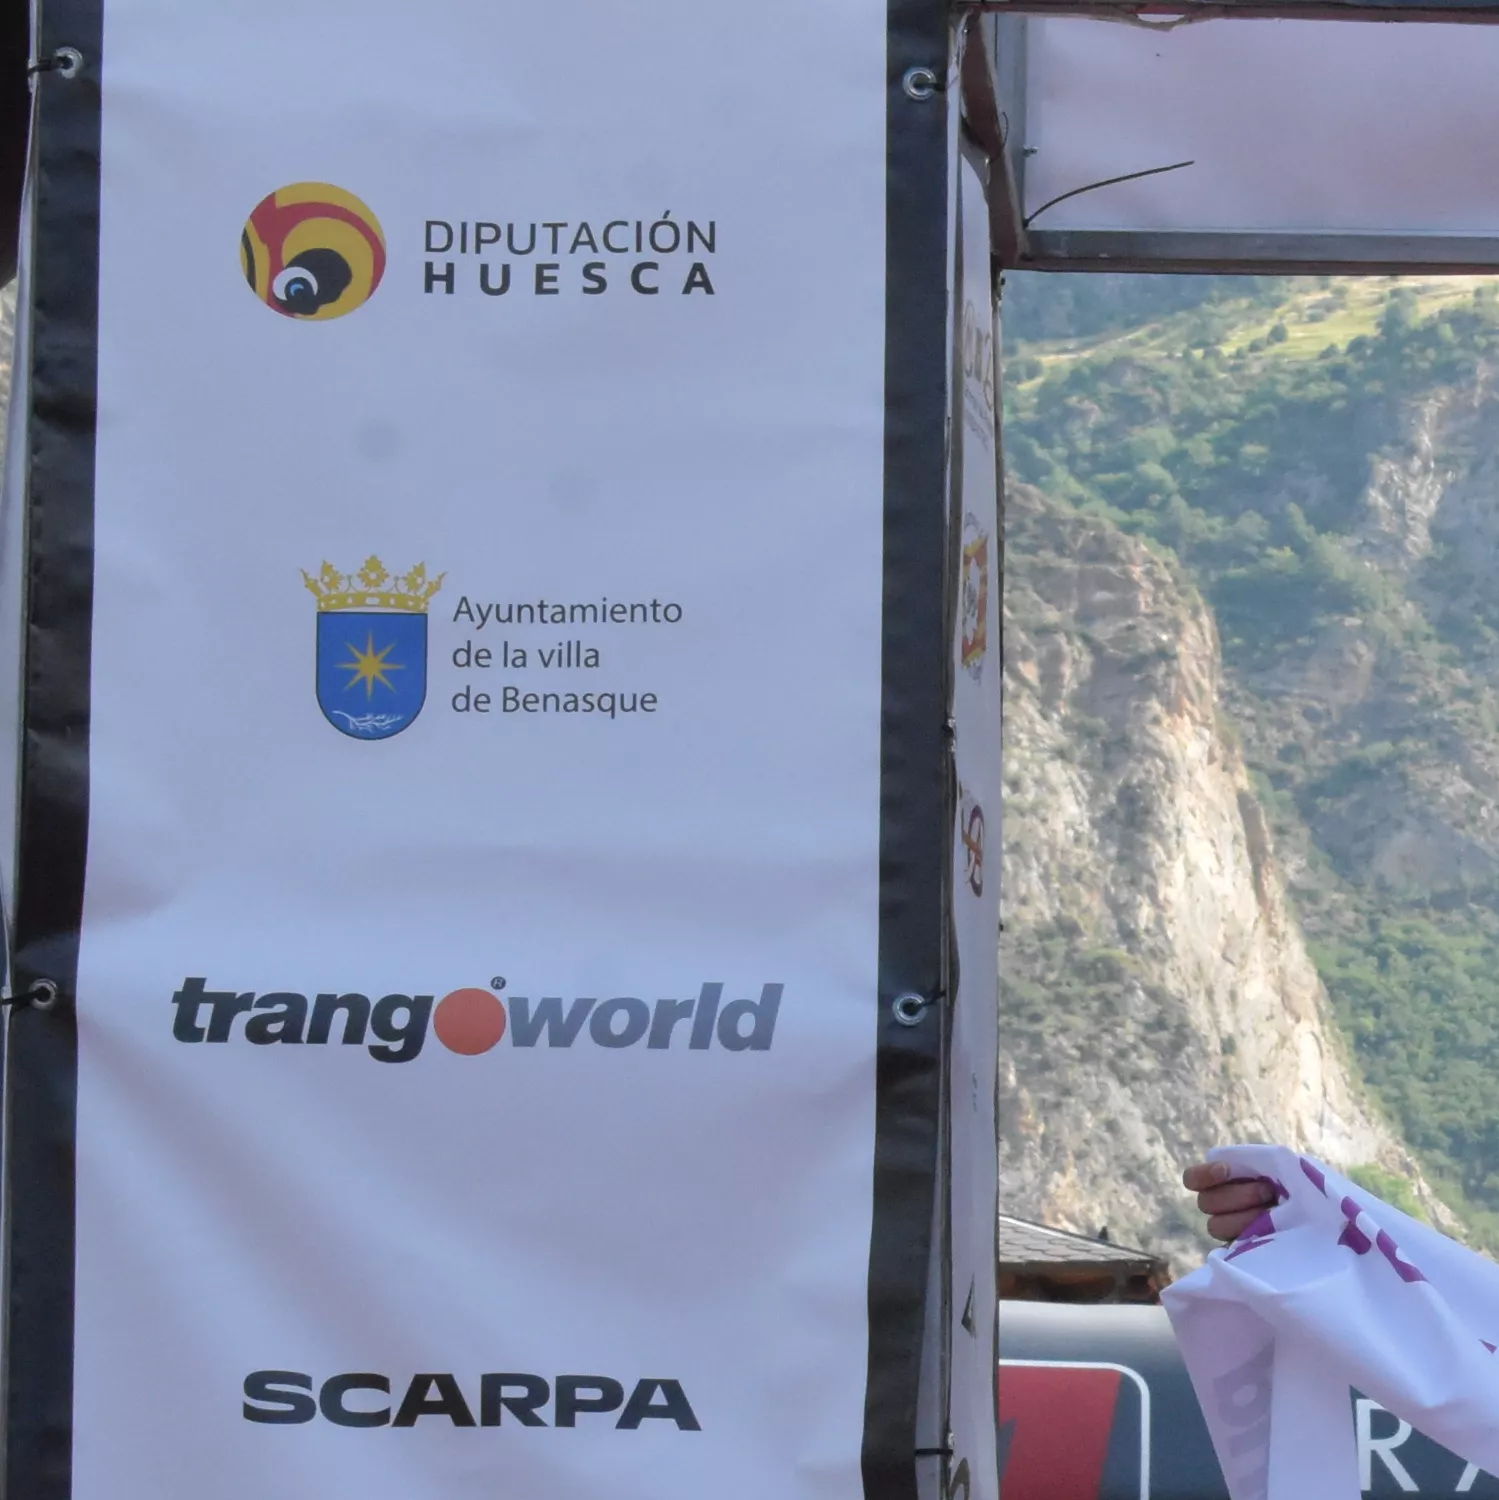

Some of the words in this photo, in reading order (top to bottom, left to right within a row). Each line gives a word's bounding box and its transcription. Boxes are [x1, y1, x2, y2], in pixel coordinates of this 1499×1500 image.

[424, 211, 718, 255] DIPUTACIÓN
[424, 261, 716, 296] HUESCA
[453, 595, 683, 632] Ayuntamiento
[452, 642, 492, 670] de
[500, 640, 528, 670] la
[537, 640, 600, 670] villa
[451, 685, 492, 713] de
[501, 684, 658, 718] Benasque
[243, 1370, 702, 1431] SCARPA
